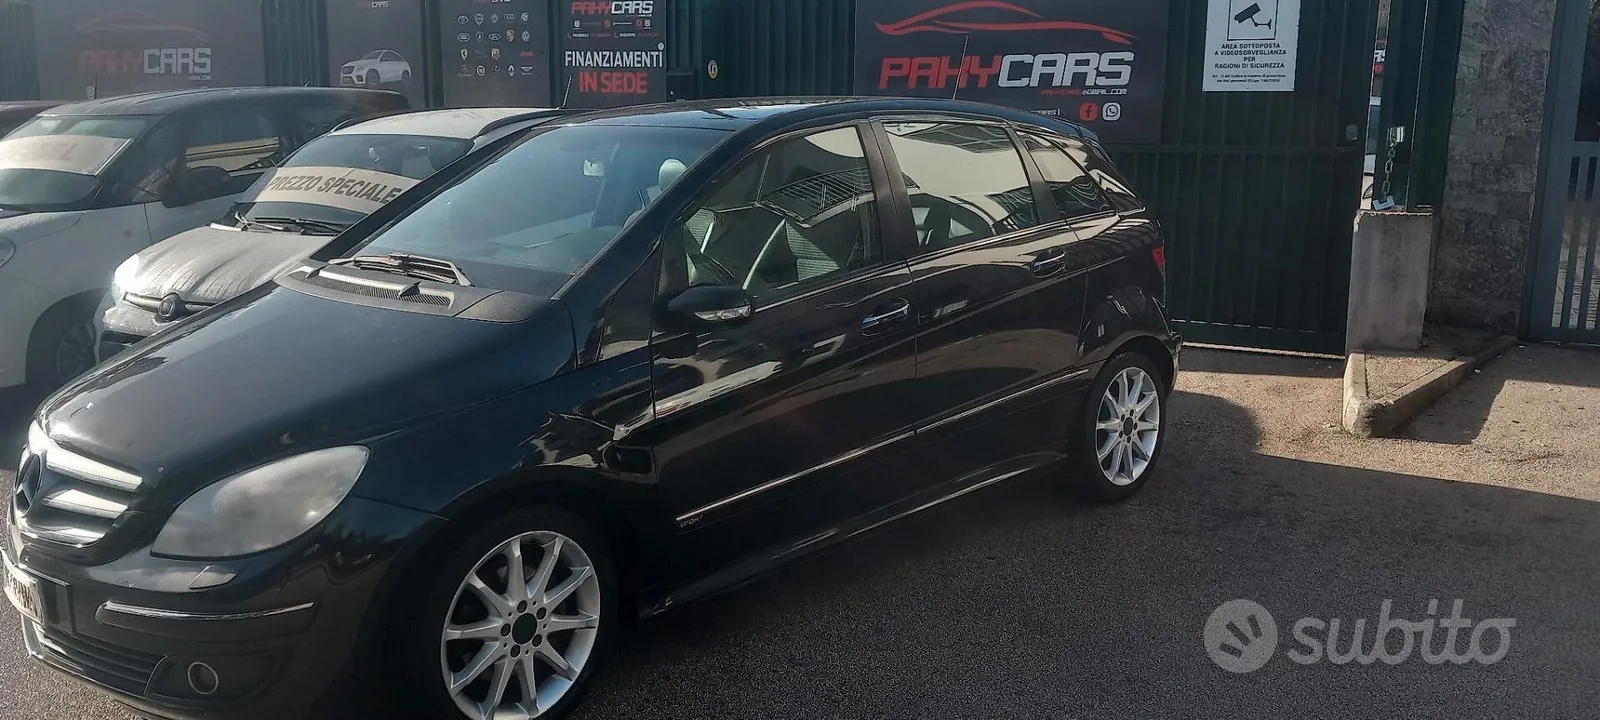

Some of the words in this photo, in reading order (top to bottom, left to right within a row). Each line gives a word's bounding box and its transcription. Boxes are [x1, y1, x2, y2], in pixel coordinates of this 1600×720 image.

[564, 50, 663, 68] FINANZIAMENTI
[579, 71, 599, 93] IN
[601, 71, 649, 94] SEDE
[269, 175, 323, 192] PREZZO
[317, 176, 403, 204] SPECIALE
